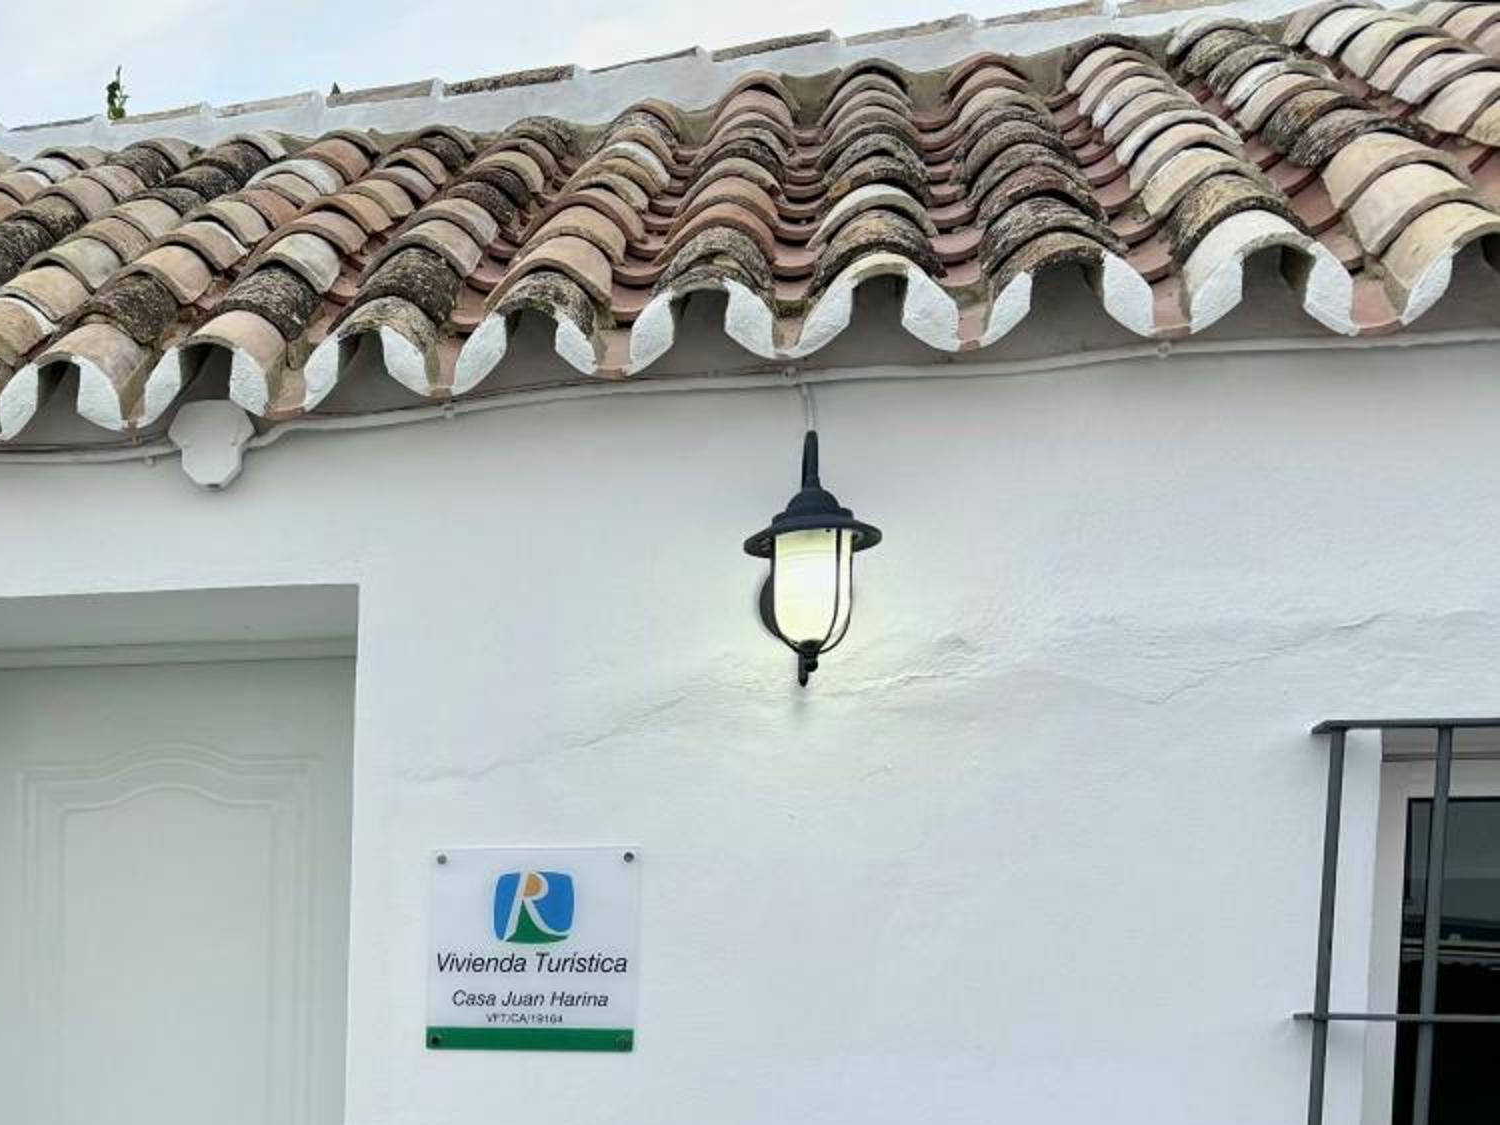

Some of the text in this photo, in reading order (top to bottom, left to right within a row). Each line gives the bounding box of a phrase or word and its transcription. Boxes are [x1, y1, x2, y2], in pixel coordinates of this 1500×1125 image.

[437, 952, 628, 973] Vivienda Turística
[452, 990, 609, 1007] Casa Juan Harina
